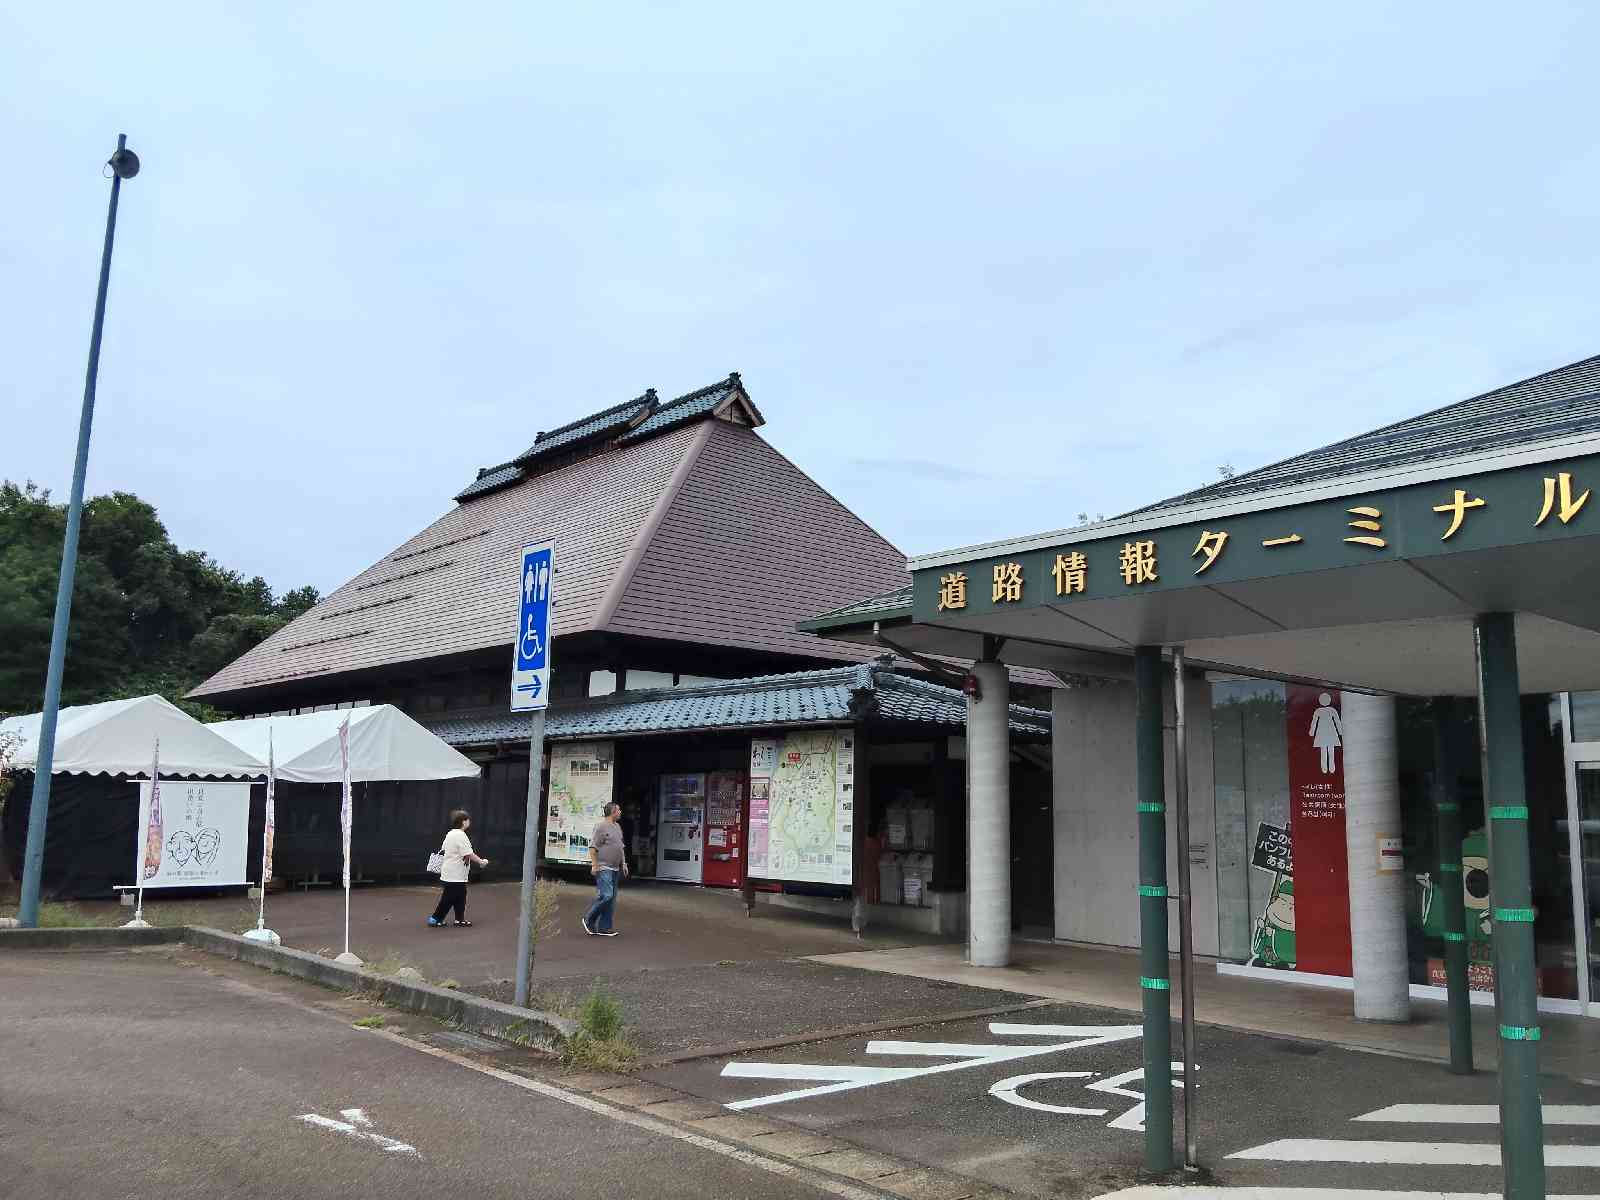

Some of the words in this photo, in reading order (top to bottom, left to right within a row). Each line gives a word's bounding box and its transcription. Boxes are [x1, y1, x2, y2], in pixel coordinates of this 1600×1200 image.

[937, 471, 1591, 613] 道路情報ターミナル
